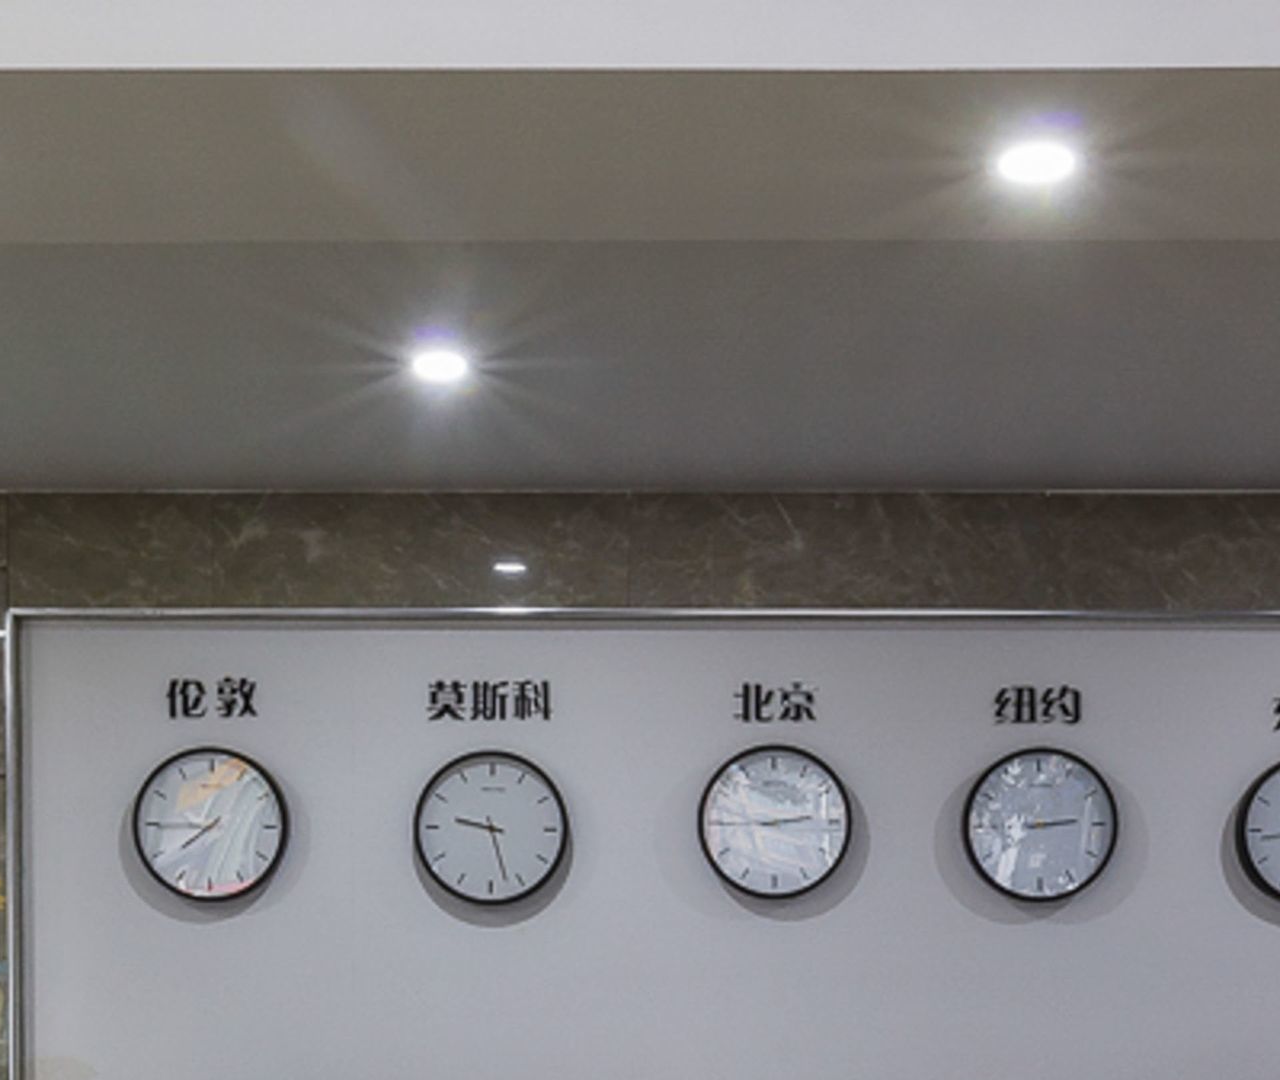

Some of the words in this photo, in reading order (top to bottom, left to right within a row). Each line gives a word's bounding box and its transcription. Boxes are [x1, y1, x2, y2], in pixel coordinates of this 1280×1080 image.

[166, 676, 257, 720] 伦敦
[428, 680, 552, 722] 莫斯科
[734, 682, 817, 723] 北京
[993, 684, 1082, 726] 纽约
